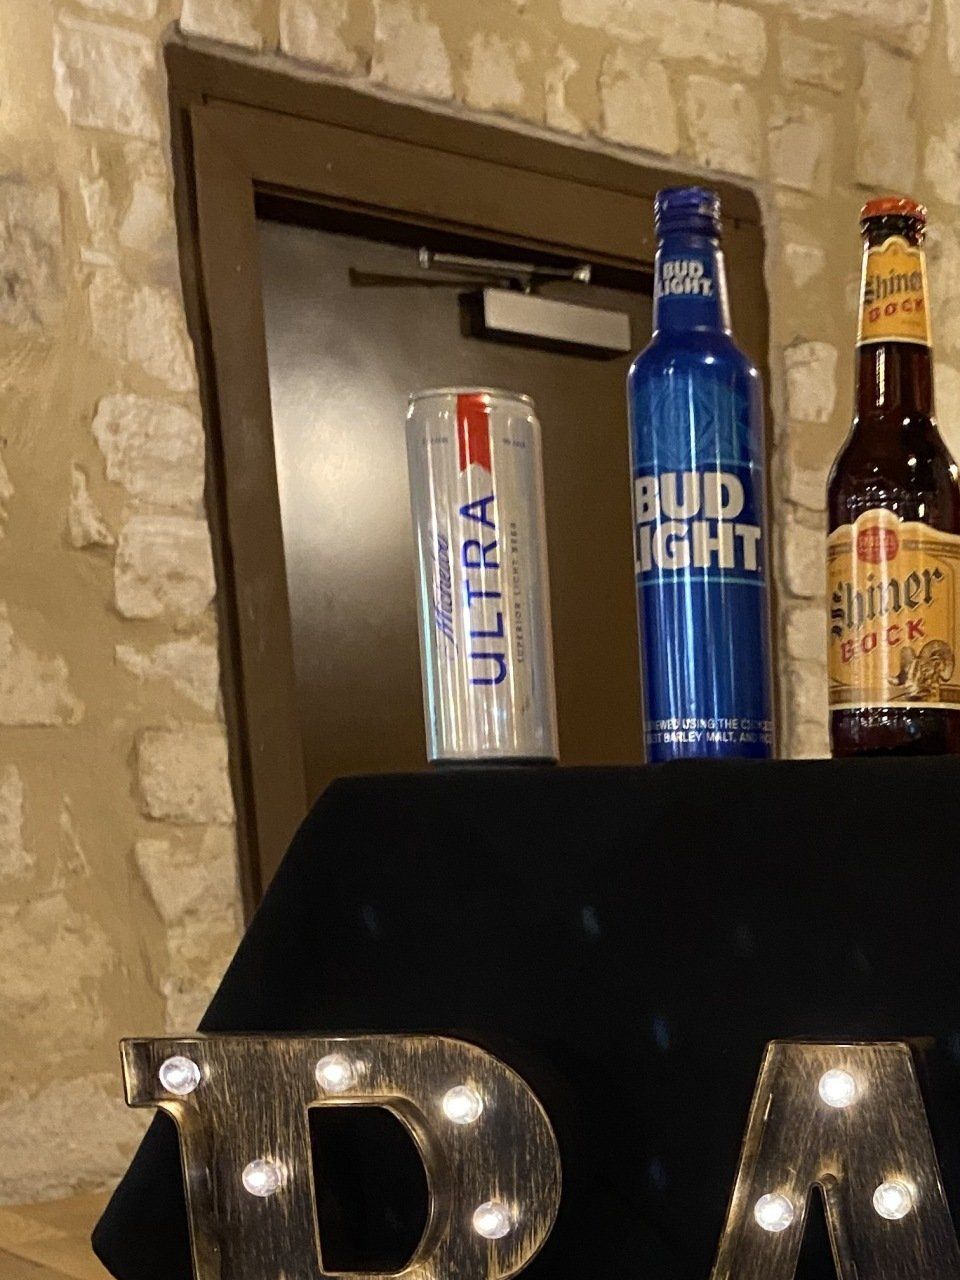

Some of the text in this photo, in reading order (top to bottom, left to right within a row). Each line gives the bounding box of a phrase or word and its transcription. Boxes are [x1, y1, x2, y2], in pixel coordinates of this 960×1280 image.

[663, 260, 704, 280] BUD
[864, 268, 921, 305] Shine
[635, 471, 745, 523] BUD
[459, 490, 508, 686] ULTRA
[831, 566, 945, 639] Shiner
[840, 617, 926, 664] BOCK
[663, 731, 702, 743] BARLEY
[682, 718, 717, 730] USING
[719, 718, 738, 730] THE
